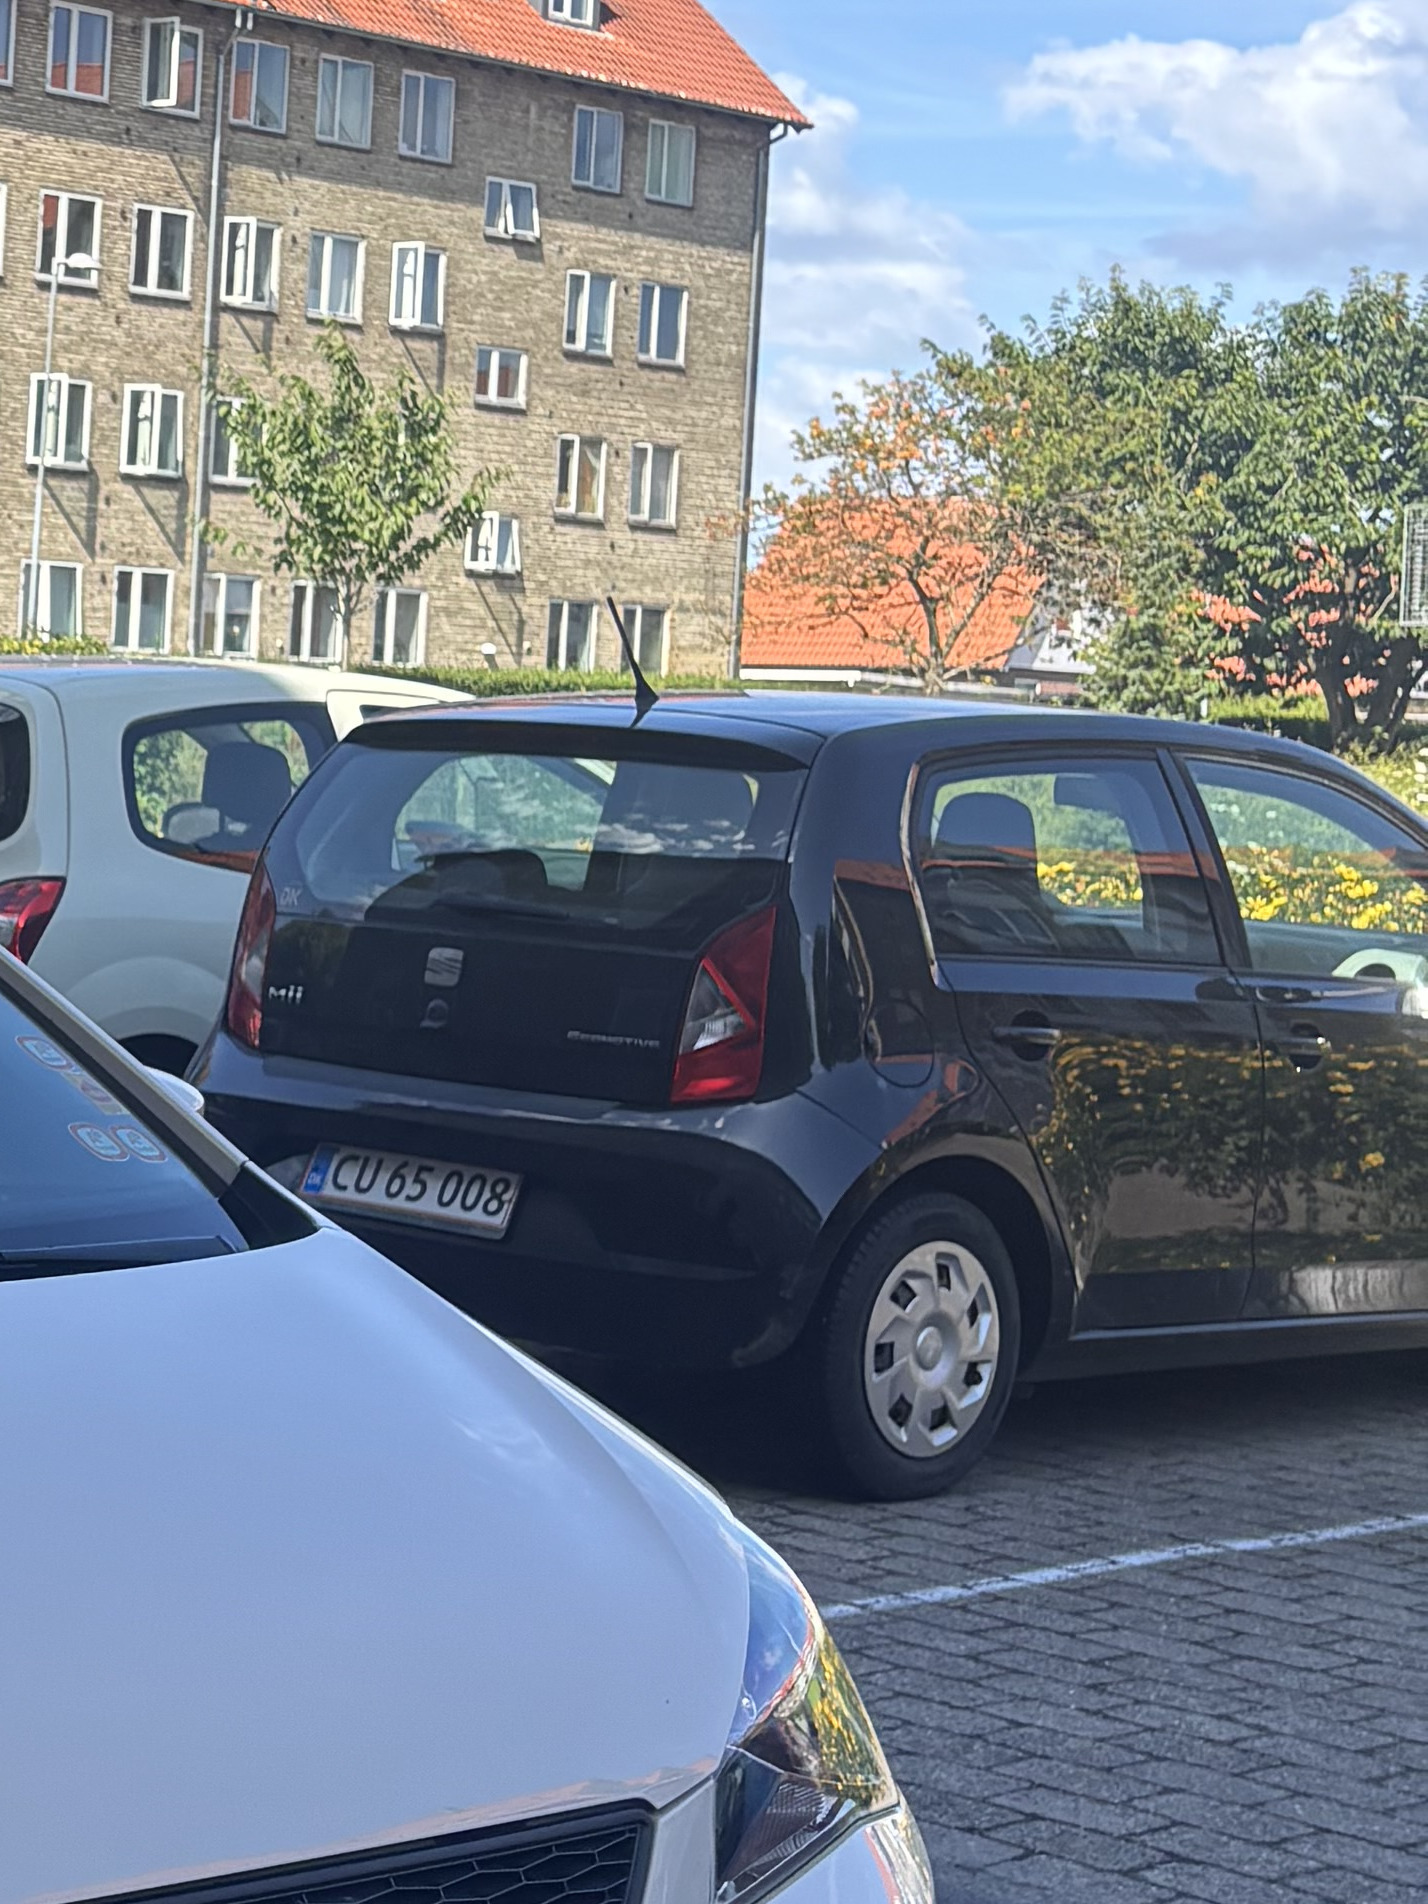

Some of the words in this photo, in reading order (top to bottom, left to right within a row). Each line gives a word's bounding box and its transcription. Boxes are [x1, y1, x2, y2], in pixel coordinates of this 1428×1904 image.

[331, 1154, 384, 1194] CU
[385, 1160, 435, 1202] 65
[437, 1169, 512, 1216] 008
